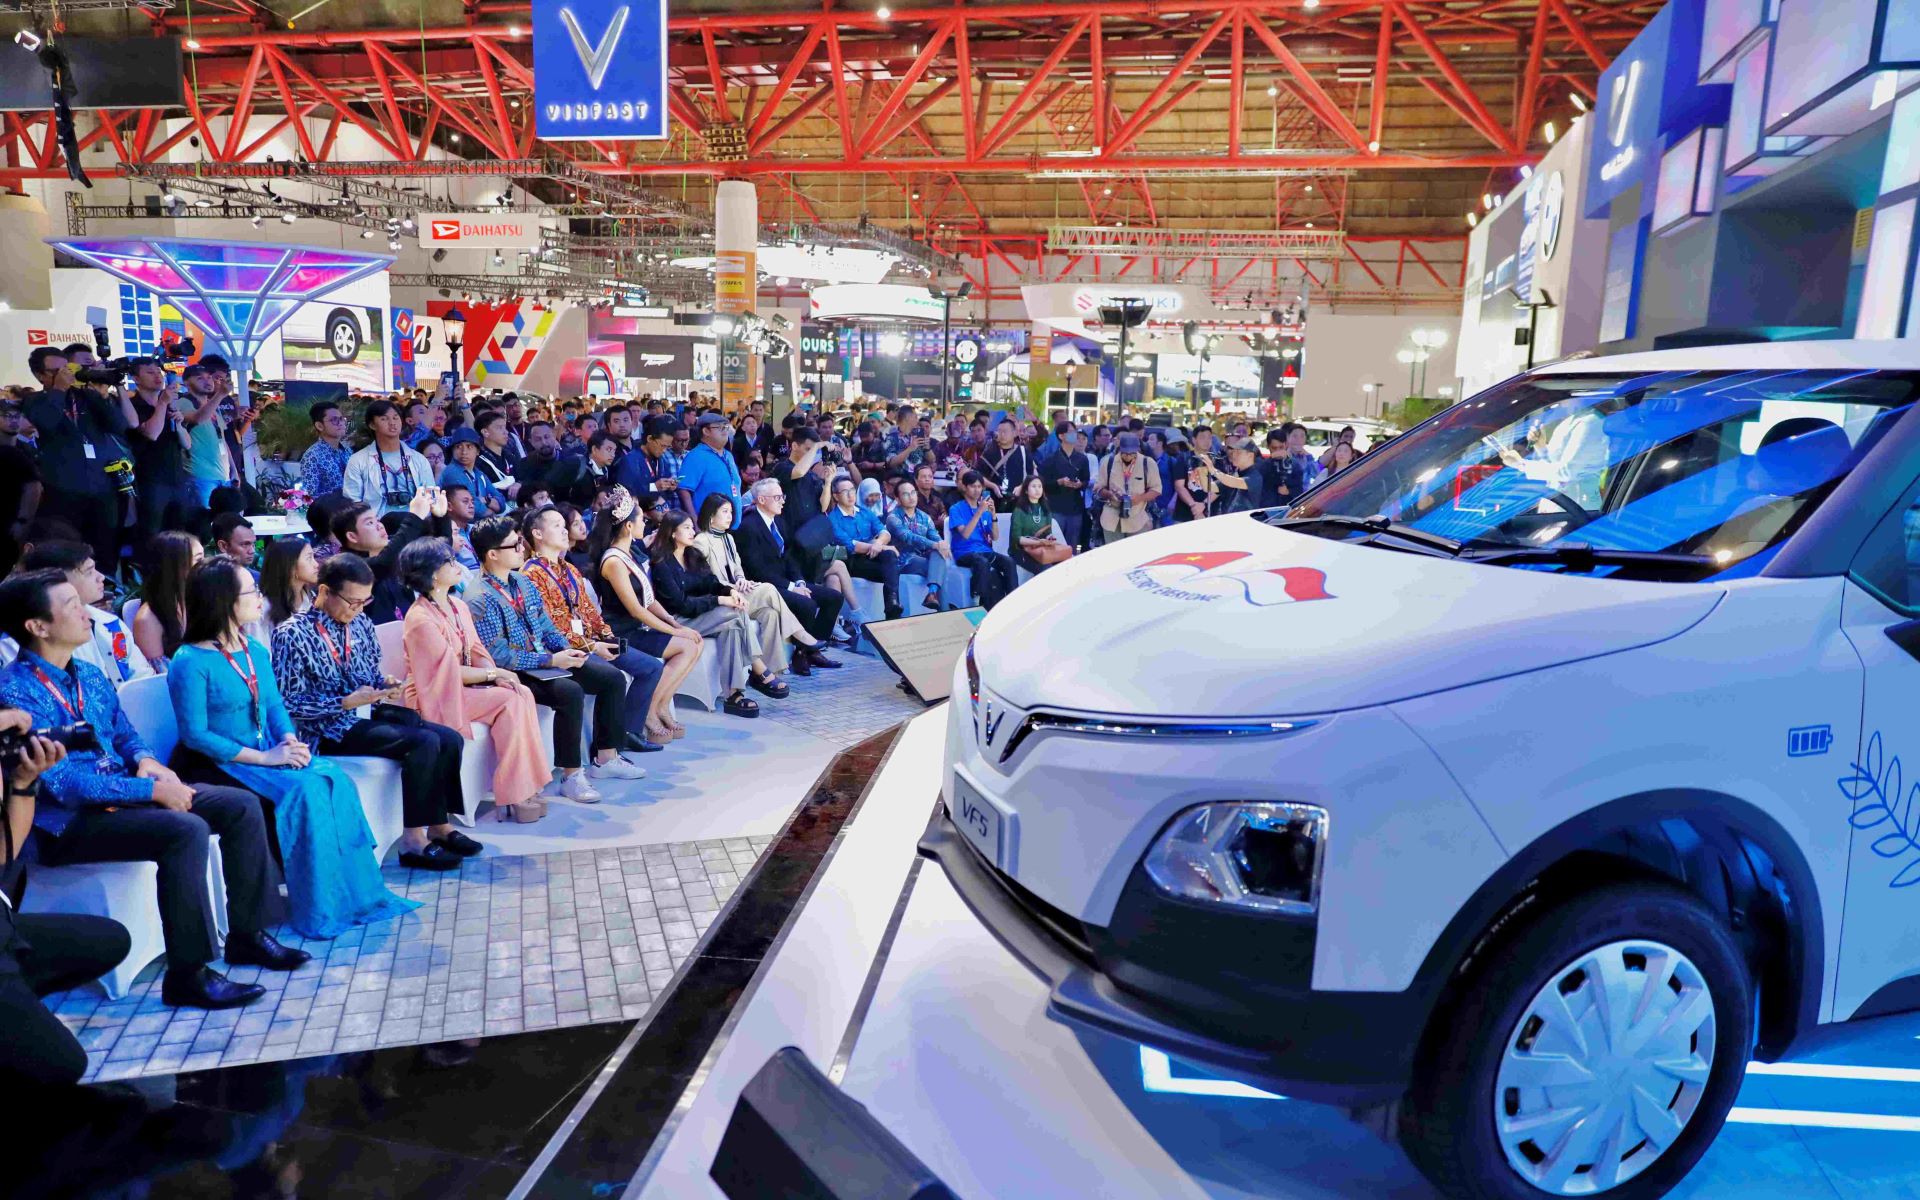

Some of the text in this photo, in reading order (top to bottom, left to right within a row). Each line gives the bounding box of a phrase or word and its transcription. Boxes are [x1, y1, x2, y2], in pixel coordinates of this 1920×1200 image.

[546, 101, 648, 121] VINFAST
[463, 224, 523, 237] DAIHATSU
[49, 332, 92, 343] DAIHATSU
[800, 337, 834, 353] OURS
[962, 796, 988, 837] VF5
